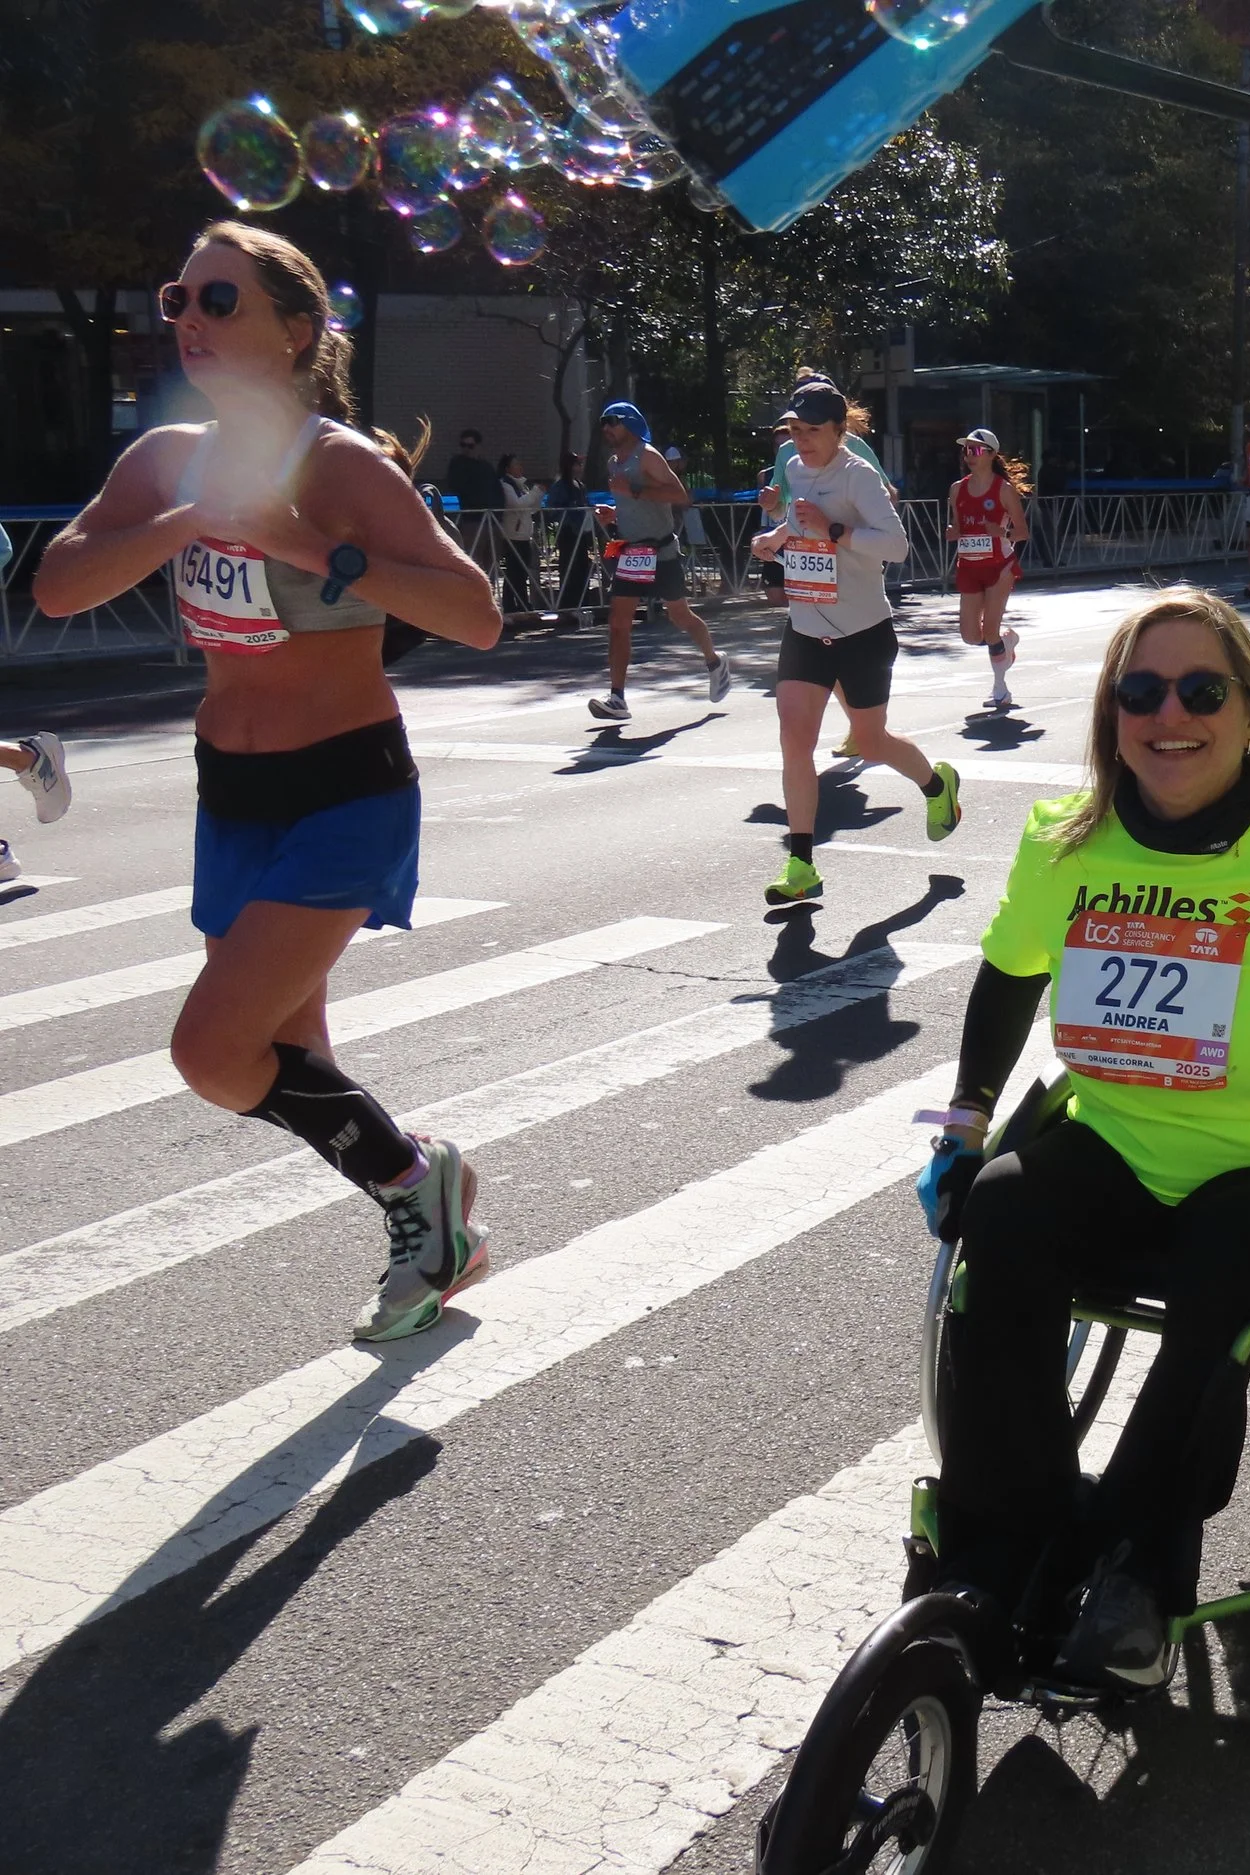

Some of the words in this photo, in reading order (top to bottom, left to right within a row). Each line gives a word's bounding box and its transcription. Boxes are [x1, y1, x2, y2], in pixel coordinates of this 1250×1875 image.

[971, 538, 991, 548] 3412
[625, 556, 652, 567] 6570
[785, 554, 797, 569] AG
[800, 555, 834, 573] 3554
[245, 632, 277, 643] 2025
[1067, 882, 1218, 923] Achilles
[1085, 918, 1121, 945] tcs
[1126, 922, 1145, 930] TATA
[1124, 930, 1176, 942] CONSULTANCY
[1122, 939, 1154, 948] SERVICES
[1189, 944, 1219, 956] TATA
[1095, 956, 1189, 1015] 272
[1102, 1012, 1169, 1032] ANDREA
[1200, 1046, 1225, 1058] AWD
[1088, 1055, 1118, 1065] ORANGE
[1119, 1058, 1154, 1068] CORRAL
[1176, 1063, 1210, 1077] 2025
